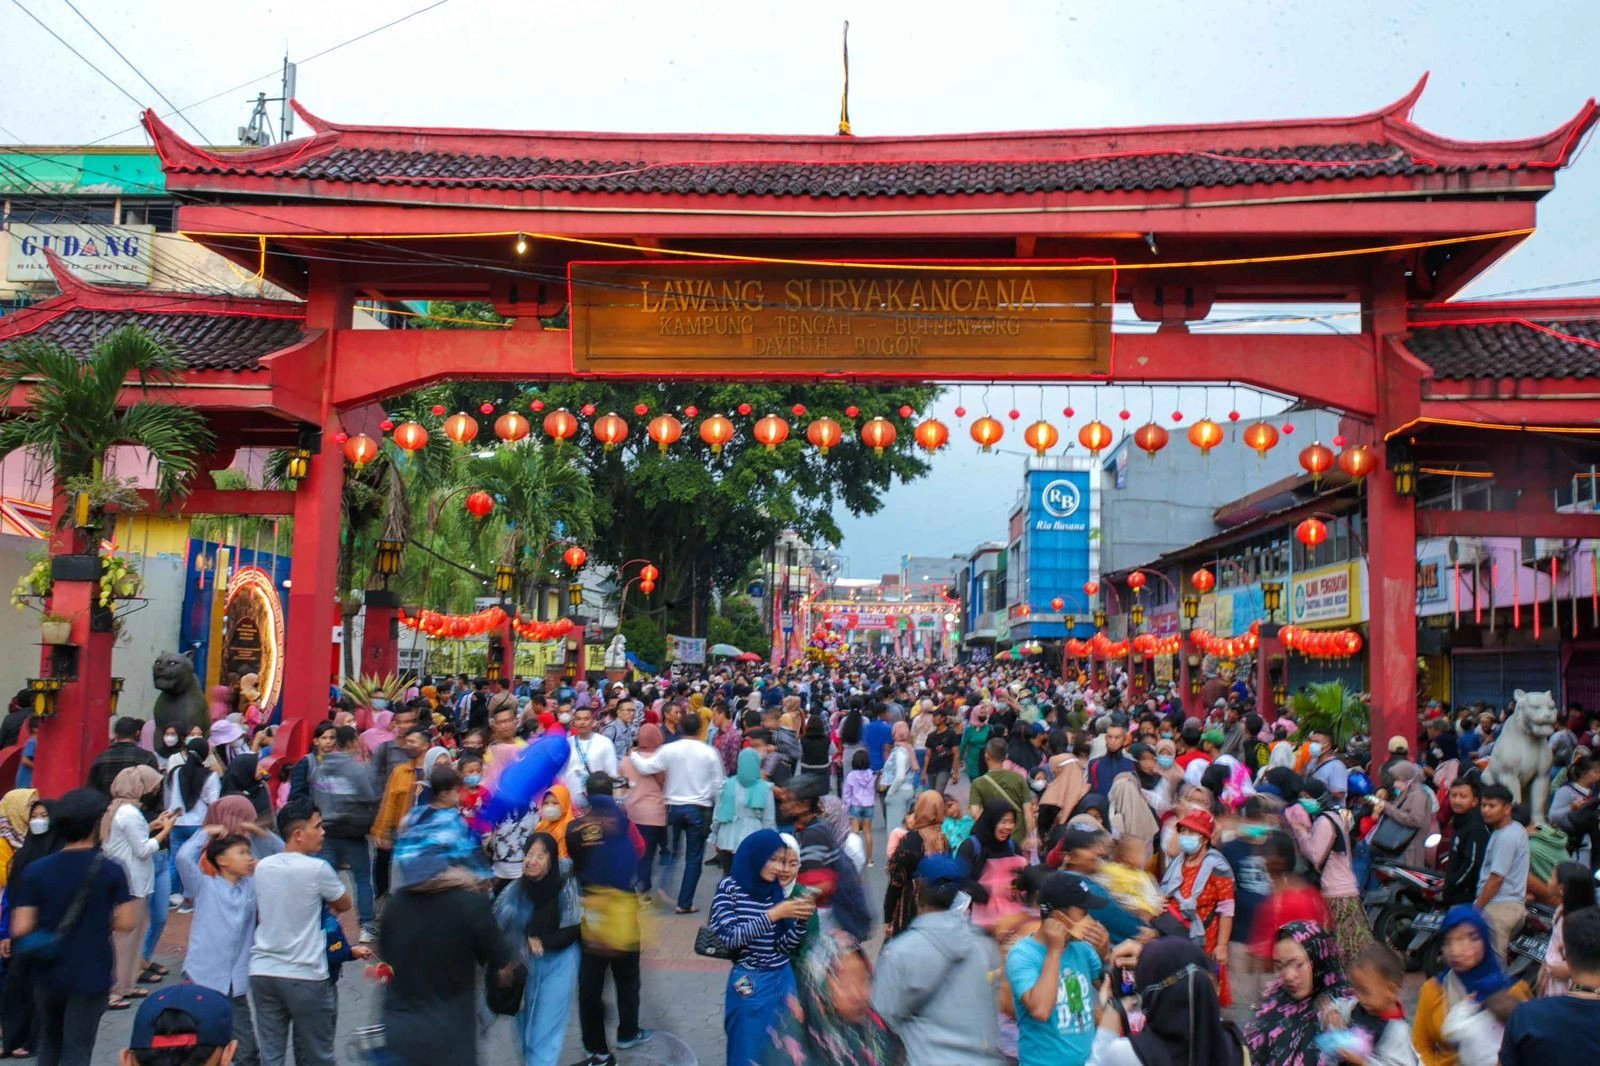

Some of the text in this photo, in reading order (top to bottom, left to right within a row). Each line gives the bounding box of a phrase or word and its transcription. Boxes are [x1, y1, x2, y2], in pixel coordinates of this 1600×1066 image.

[21, 235, 139, 257] GUDANG
[640, 279, 1039, 313] LAWANG SURYAKANCANA
[660, 316, 754, 336] KAMPUNG
[775, 316, 851, 336] TENGAH
[854, 336, 921, 355] BOGOR
[1049, 488, 1075, 510] RB
[1053, 520, 1085, 531] Busana
